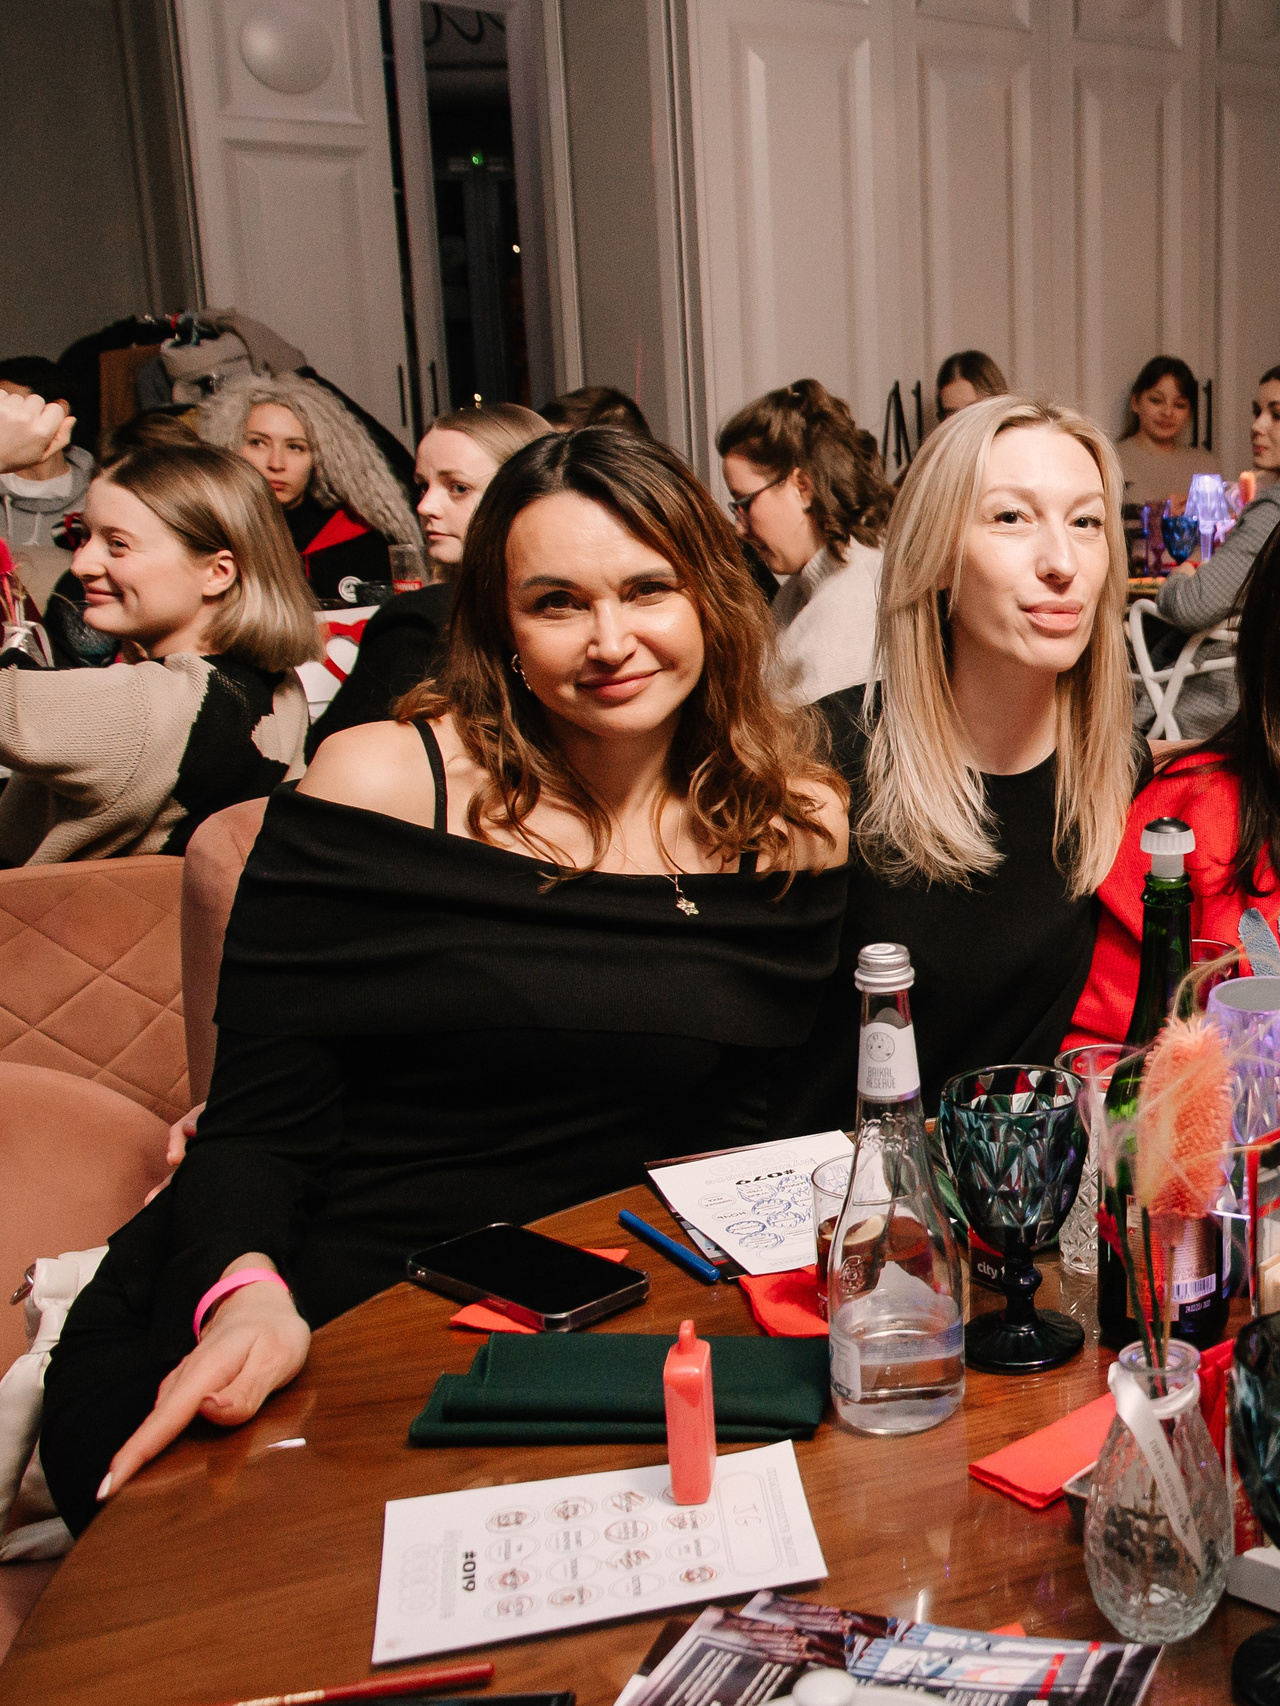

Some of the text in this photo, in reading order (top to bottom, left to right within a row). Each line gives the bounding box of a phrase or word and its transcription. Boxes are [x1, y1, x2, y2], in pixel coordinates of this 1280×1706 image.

[867, 1066, 895, 1078] BAIKAL
[866, 1077, 897, 1089] RESERVE
[735, 1168, 796, 1186] #079
[716, 1211, 747, 1220] НОЧЬ
[977, 1261, 998, 1280] city
[461, 1549, 478, 1593] #019
